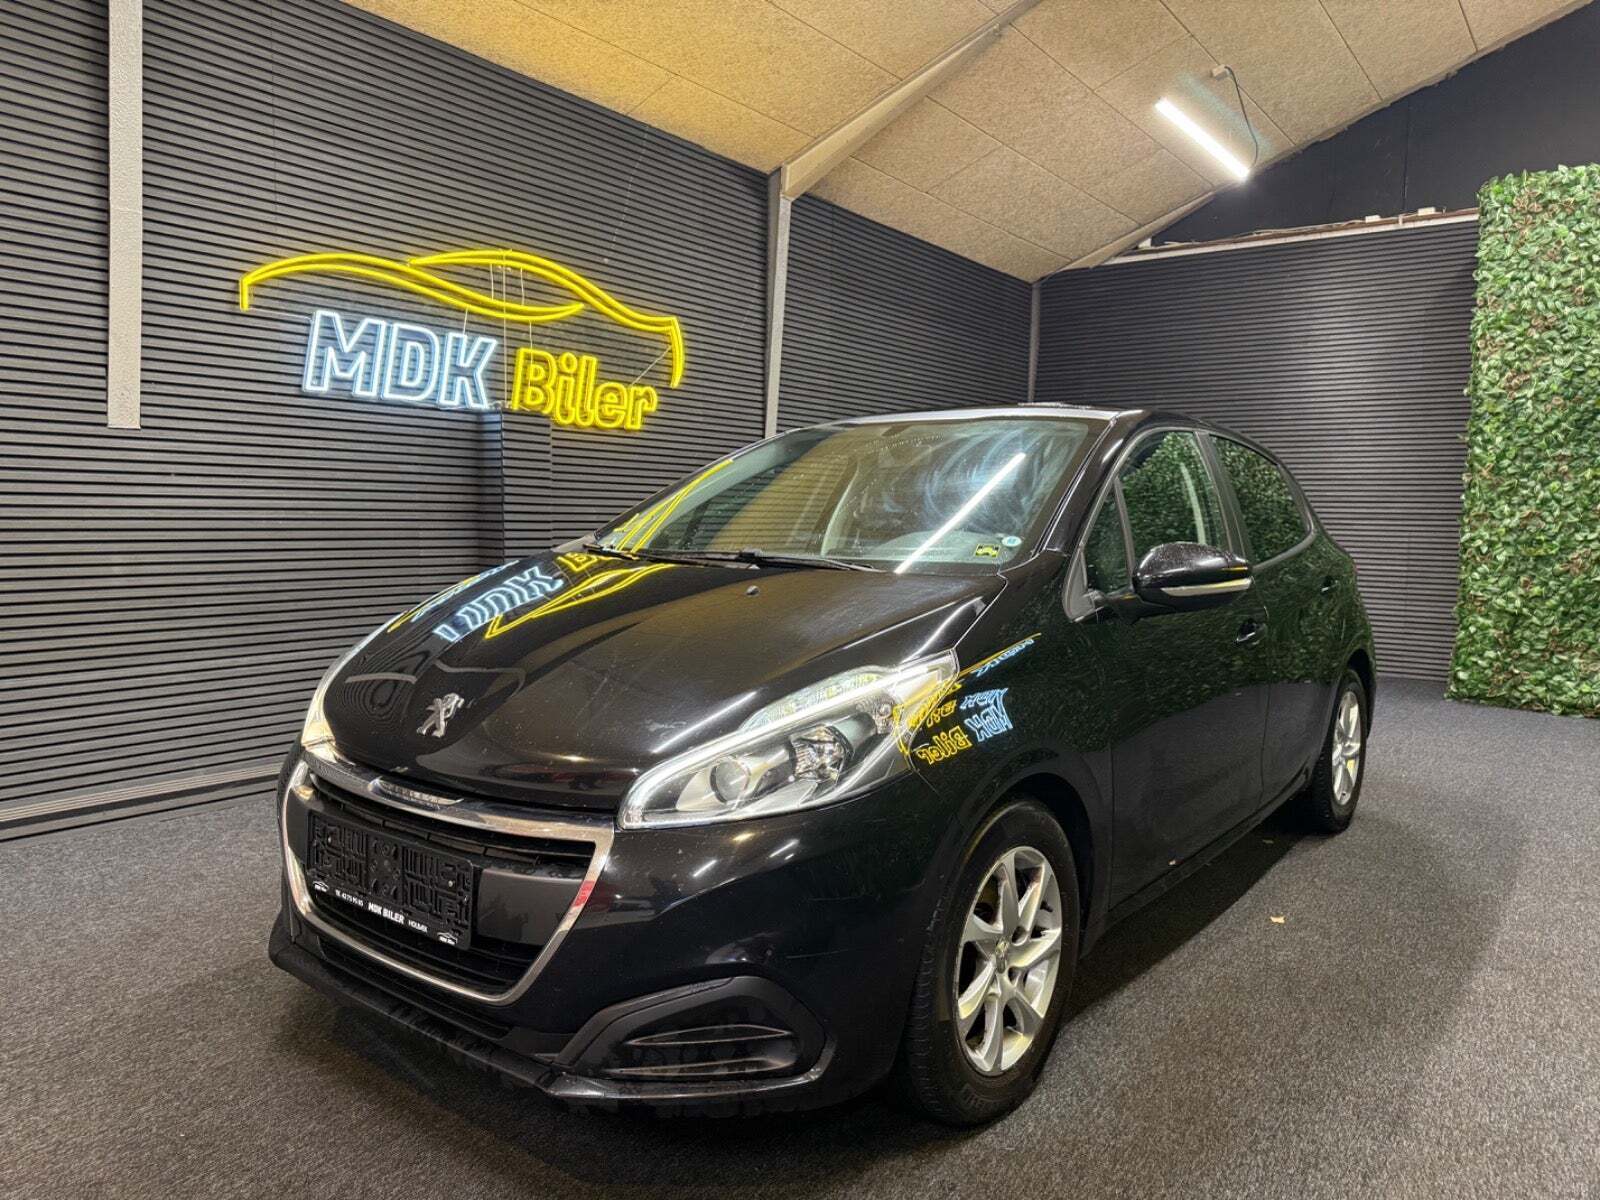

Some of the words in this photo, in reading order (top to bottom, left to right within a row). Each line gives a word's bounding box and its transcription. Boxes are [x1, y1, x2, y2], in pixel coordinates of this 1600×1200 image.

[302, 309, 498, 410] MDK
[510, 346, 660, 431] Biler
[383, 908, 404, 924] BILER
